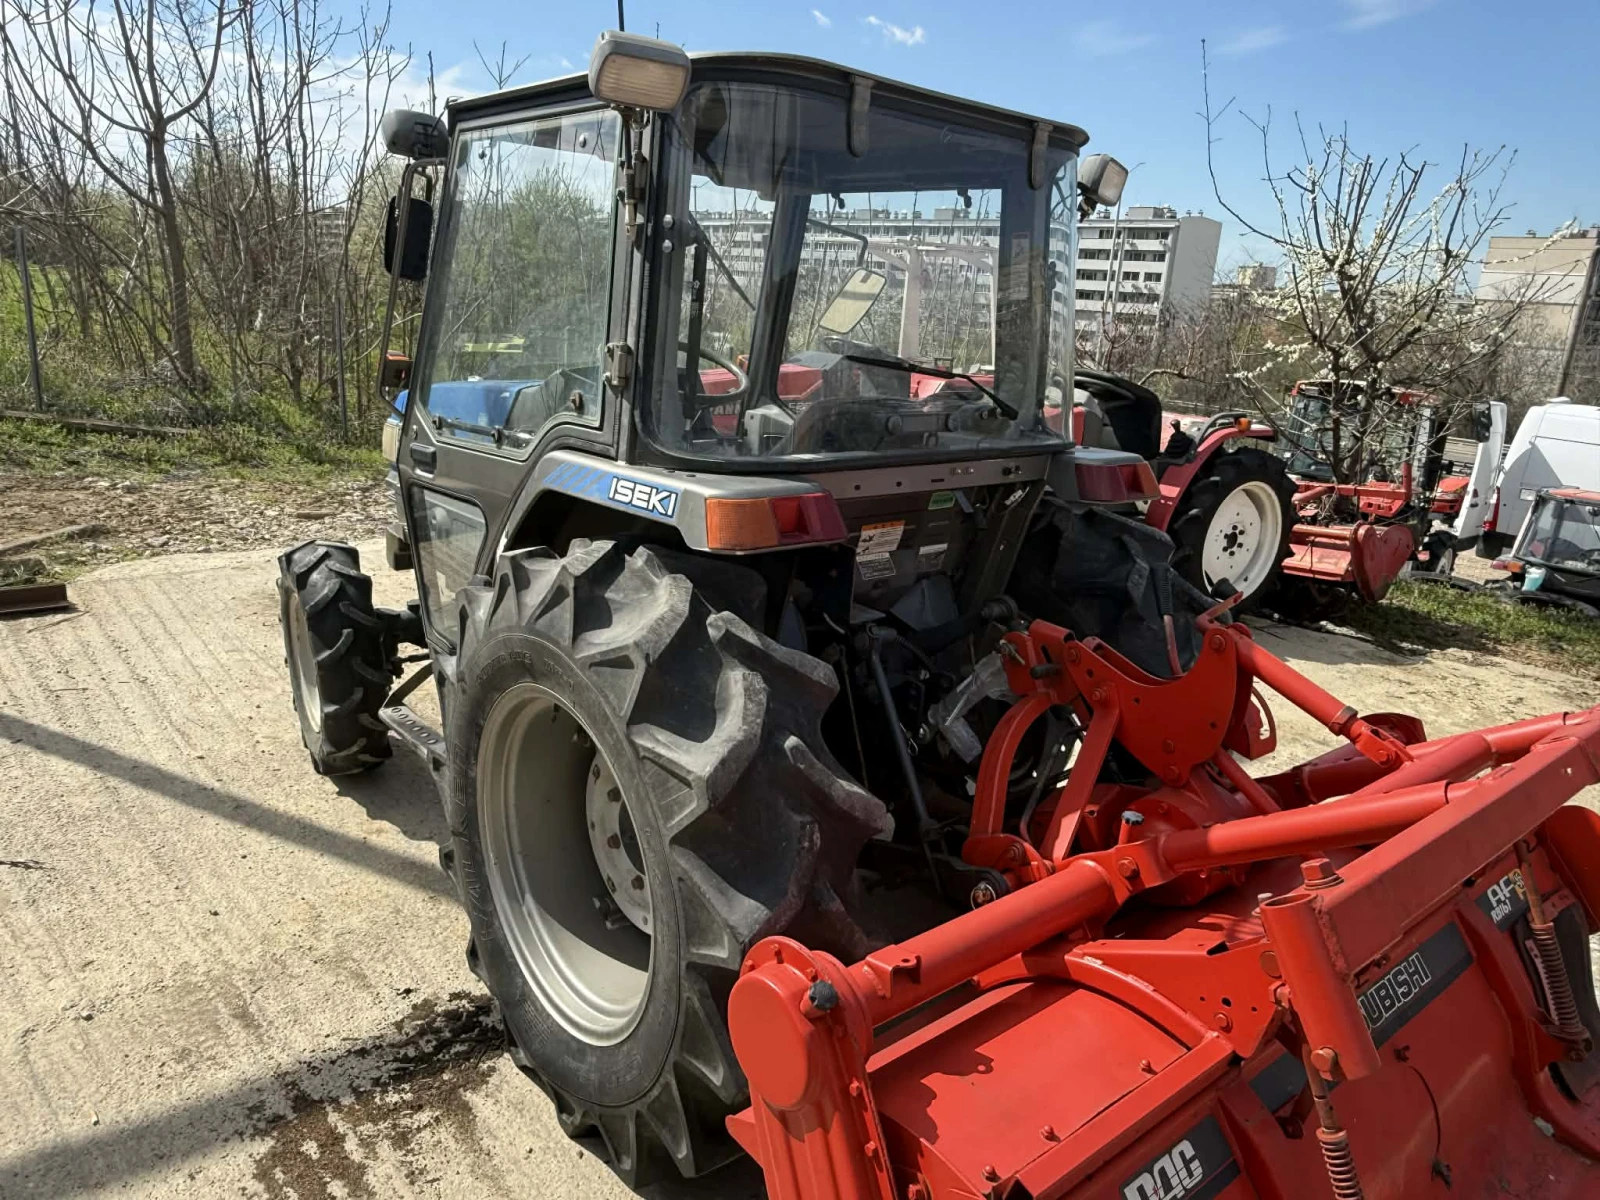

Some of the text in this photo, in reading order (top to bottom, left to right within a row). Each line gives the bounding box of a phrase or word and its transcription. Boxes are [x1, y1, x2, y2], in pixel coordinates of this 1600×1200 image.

[608, 476, 679, 518] ISEKI
[1486, 875, 1514, 907] AF
[1357, 952, 1432, 1031] UBISHI
